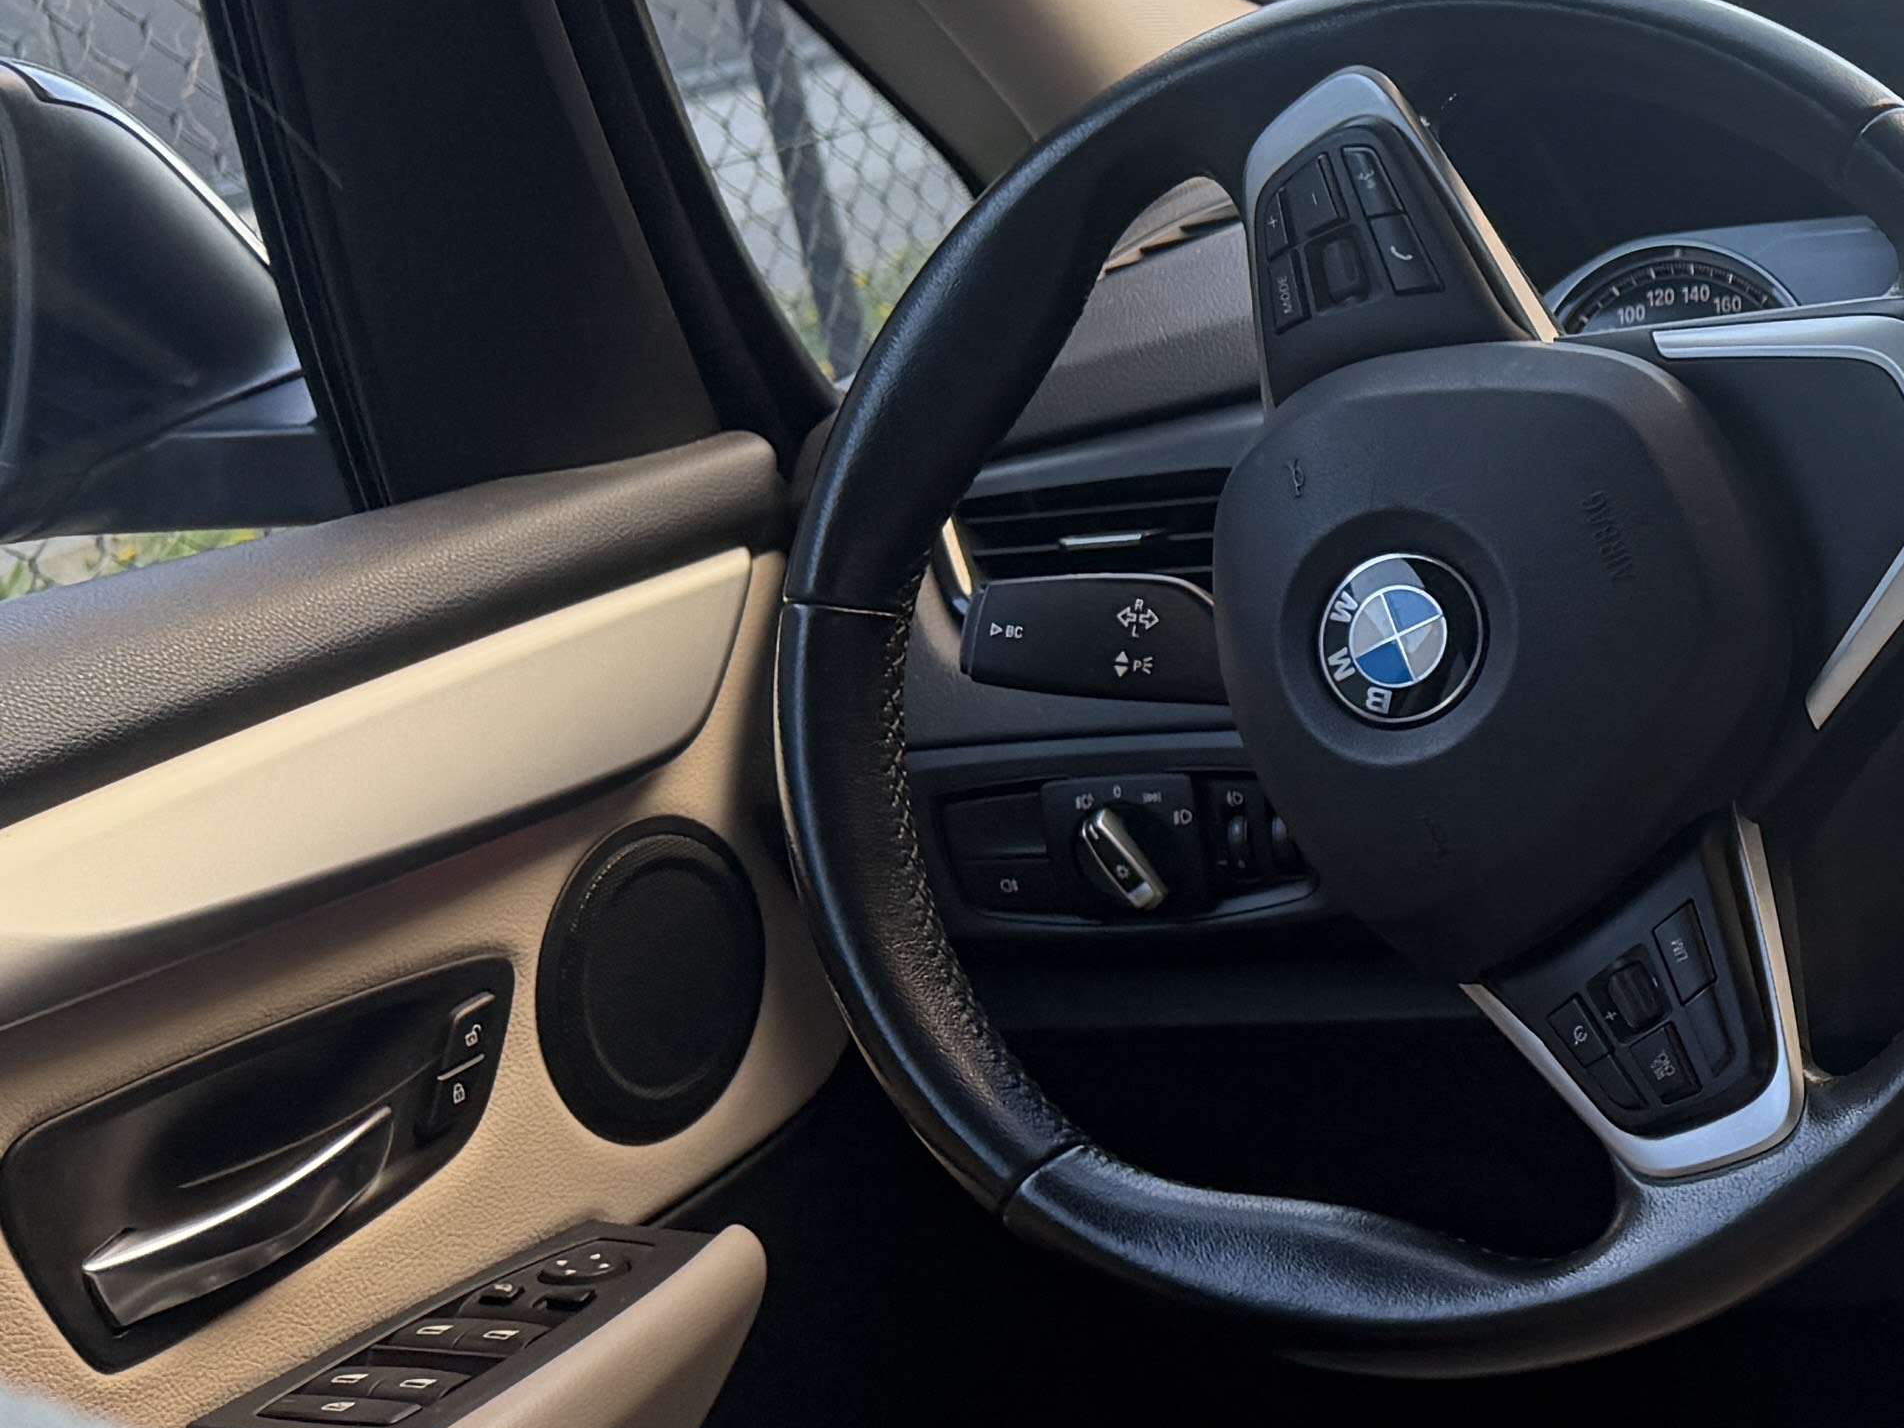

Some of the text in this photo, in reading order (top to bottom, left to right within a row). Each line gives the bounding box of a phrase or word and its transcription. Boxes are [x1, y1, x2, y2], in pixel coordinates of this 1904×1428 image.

[1617, 284, 1743, 325] 100 120 140 160
[1133, 598, 1144, 611] R
[1004, 624, 1024, 639] BC
[1131, 624, 1140, 638] L
